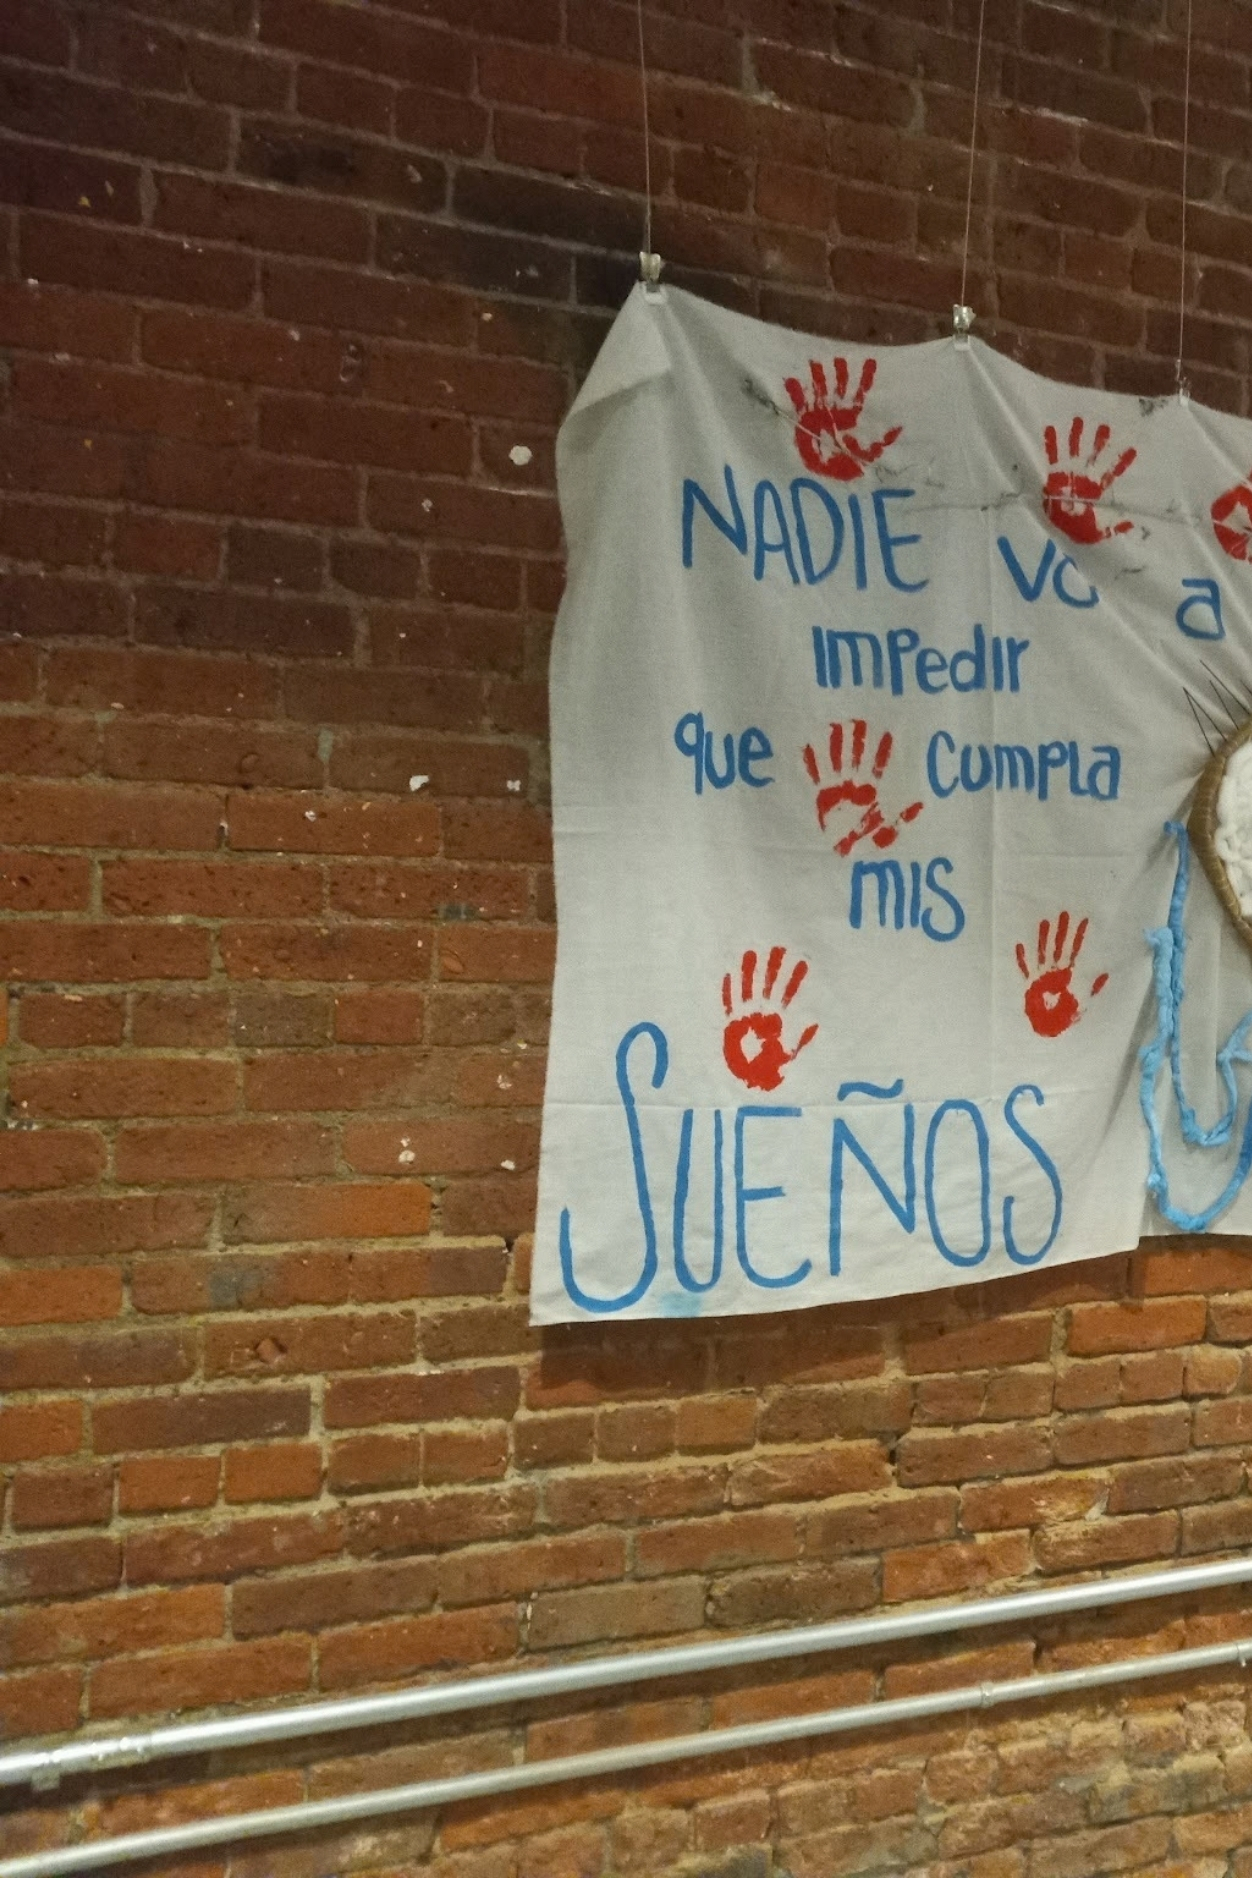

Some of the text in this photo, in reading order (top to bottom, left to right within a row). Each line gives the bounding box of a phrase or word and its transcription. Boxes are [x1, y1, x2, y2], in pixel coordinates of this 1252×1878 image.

[681, 464, 929, 593] NADIE
[1175, 578, 1225, 640] a
[674, 712, 775, 794] que
[559, 1021, 1063, 1313] SUEÑOS
